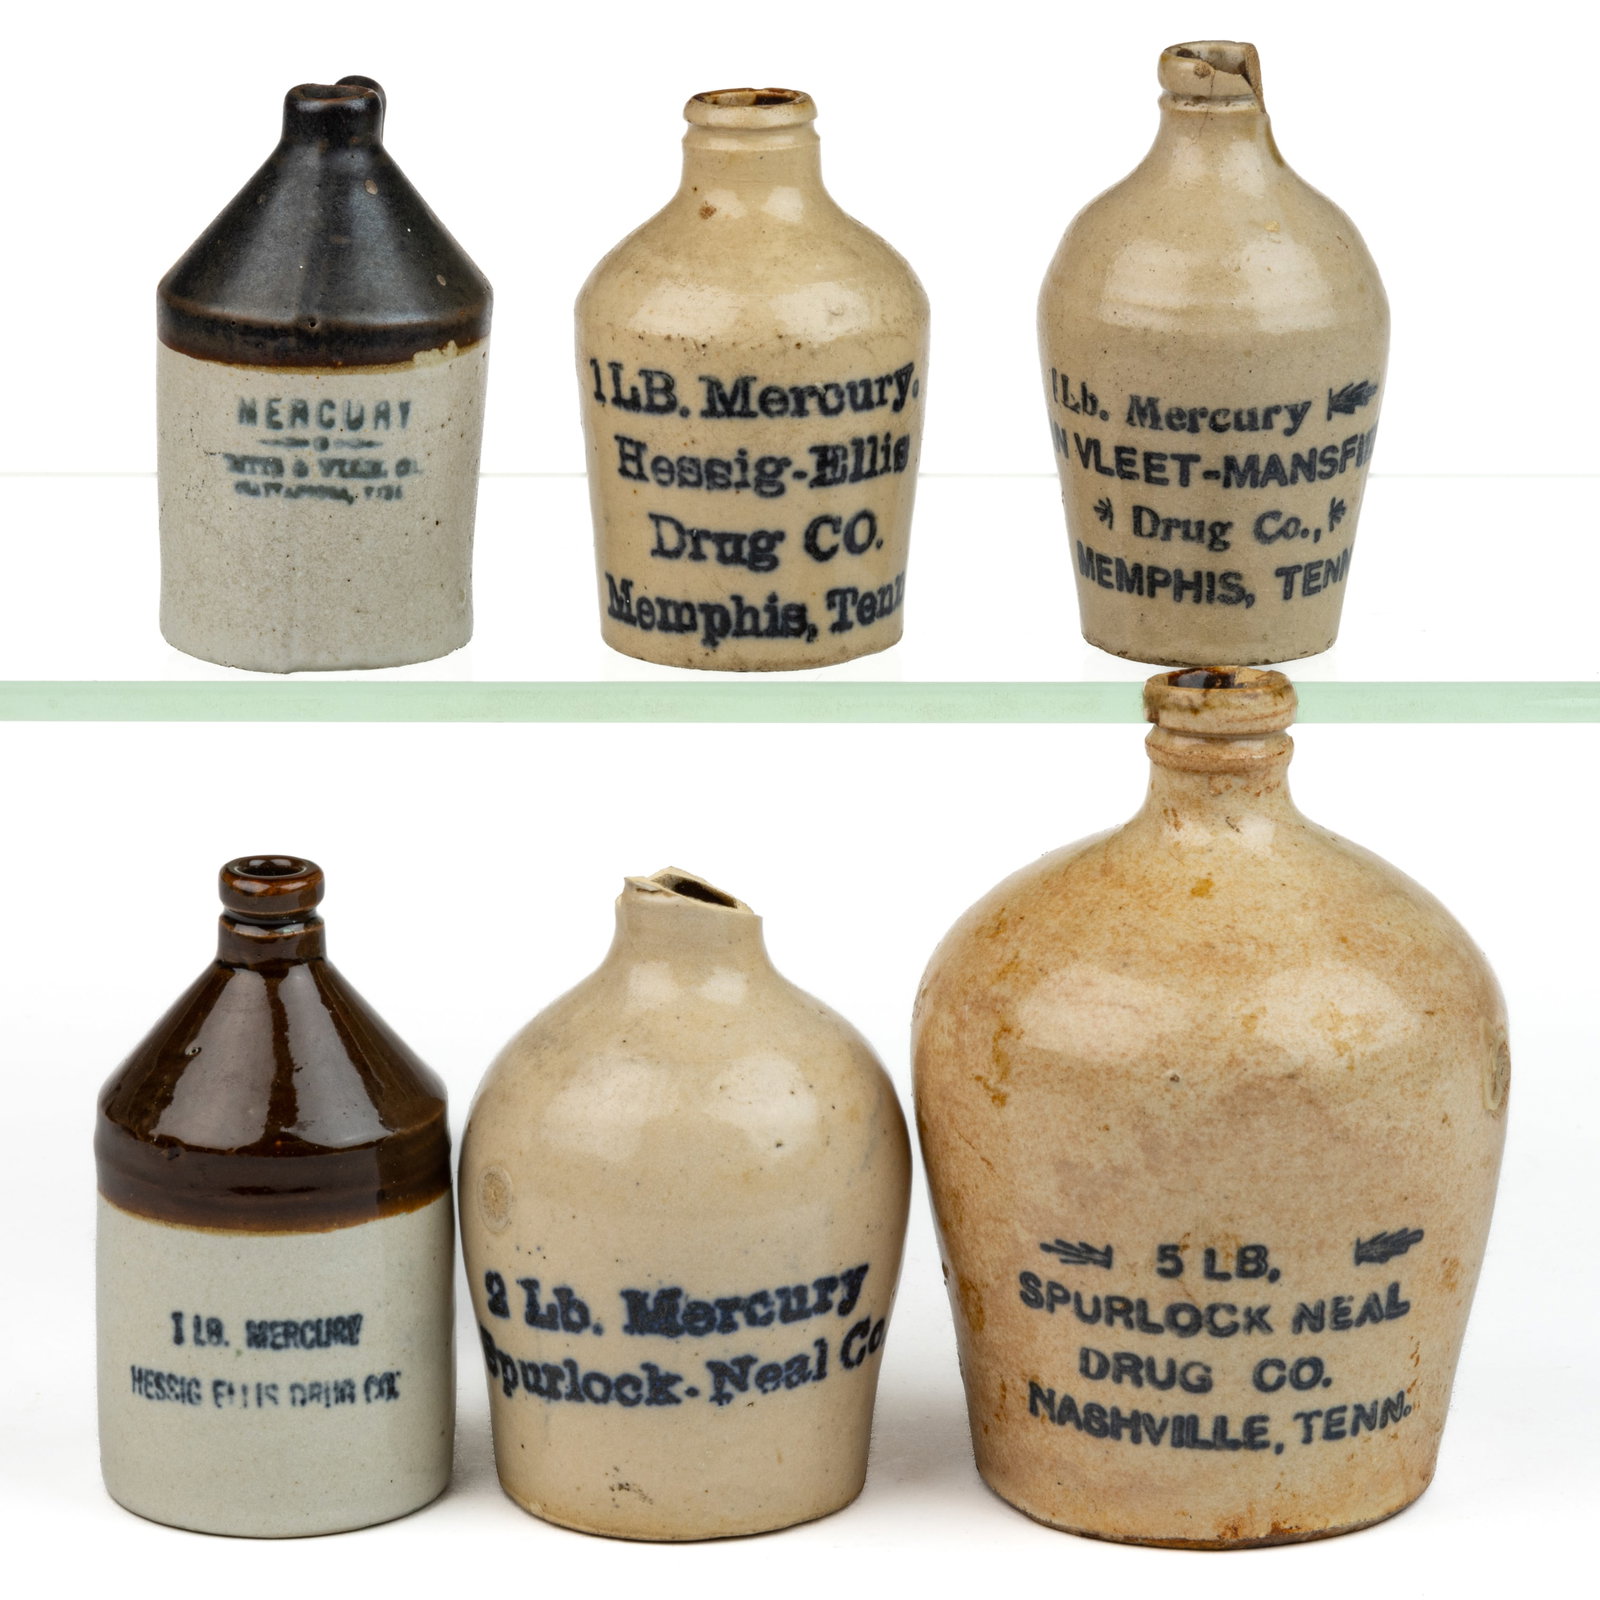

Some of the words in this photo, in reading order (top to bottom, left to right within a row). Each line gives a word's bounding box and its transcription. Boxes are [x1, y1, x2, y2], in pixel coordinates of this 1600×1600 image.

[1126, 394, 1312, 437] Mercury
[614, 433, 909, 498] Hessig-Ellis
[649, 512, 786, 573] Drug
[804, 509, 884, 562] CO.
[1132, 505, 1234, 552] Drug
[1254, 510, 1321, 543] Co.,
[1077, 541, 1255, 609] MEMPHIS,
[606, 573, 818, 648] Memphis,
[1156, 1243, 1184, 1279] 5
[485, 1268, 511, 1319] 2
[517, 1277, 604, 1337] Lb.
[619, 1263, 870, 1338] Mercury
[1018, 1270, 1274, 1338] SPURLOCK
[1292, 1281, 1411, 1335] NEAL
[245, 1313, 363, 1351] MERCURY
[839, 1316, 885, 1370] Co
[130, 1364, 203, 1405] HESSIG
[1078, 1346, 1214, 1394] DRUG
[1252, 1356, 1333, 1393] CO.
[1027, 1381, 1285, 1456] NASHVILLE,
[1293, 1390, 1413, 1445] TENN.
